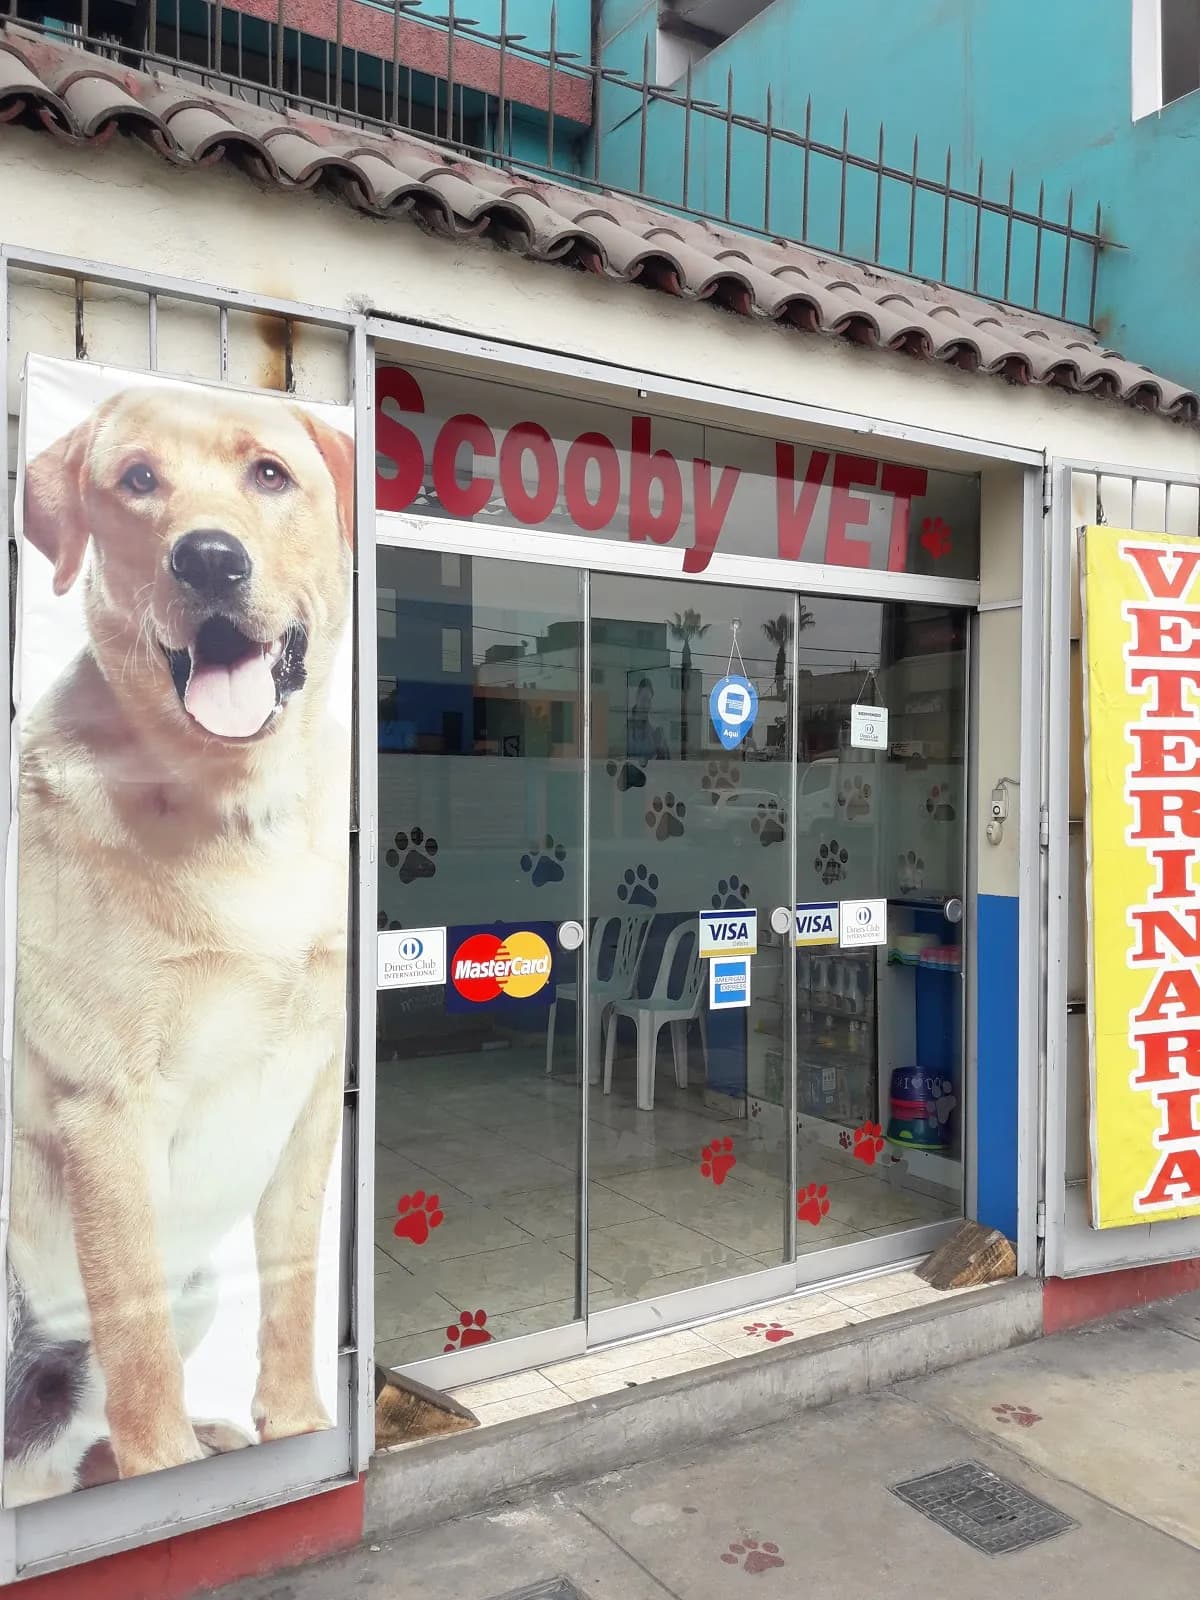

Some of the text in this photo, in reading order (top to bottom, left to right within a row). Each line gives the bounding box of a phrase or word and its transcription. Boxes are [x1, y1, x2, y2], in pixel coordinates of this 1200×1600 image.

[375, 366, 928, 574] Scooby VET
[1123, 546, 1200, 1206] VETERINARIA
[707, 922, 749, 941] VISA
[796, 915, 833, 934] VISA
[384, 958, 436, 973] Diners Club
[384, 968, 436, 980] INTERNATIONAL
[454, 956, 549, 980] MasterCard
[714, 976, 746, 984] AMERICAN
[721, 983, 747, 991] EXPRESS
